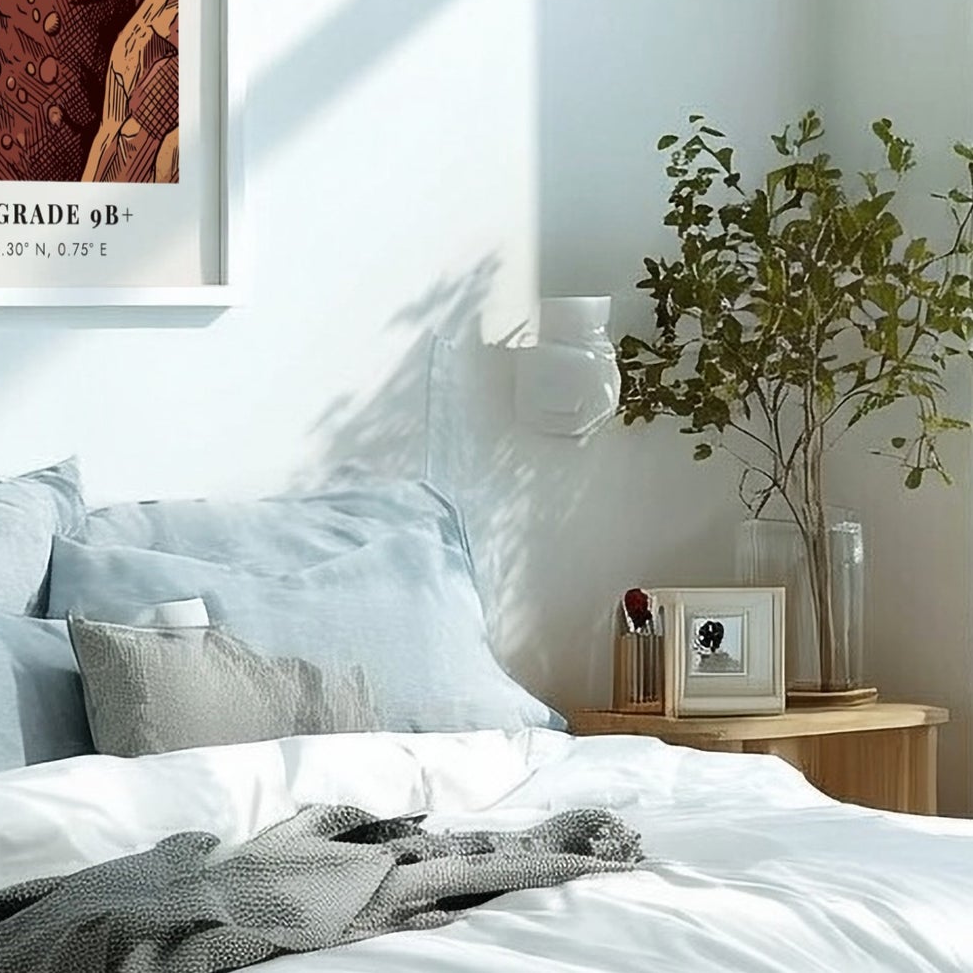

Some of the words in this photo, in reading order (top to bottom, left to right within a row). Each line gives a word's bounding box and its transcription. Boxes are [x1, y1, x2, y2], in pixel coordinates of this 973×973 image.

[89, 204, 134, 229] 9B+
[35, 242, 51, 259] N,
[57, 242, 95, 258] 0.75°
[100, 243, 108, 257] E
